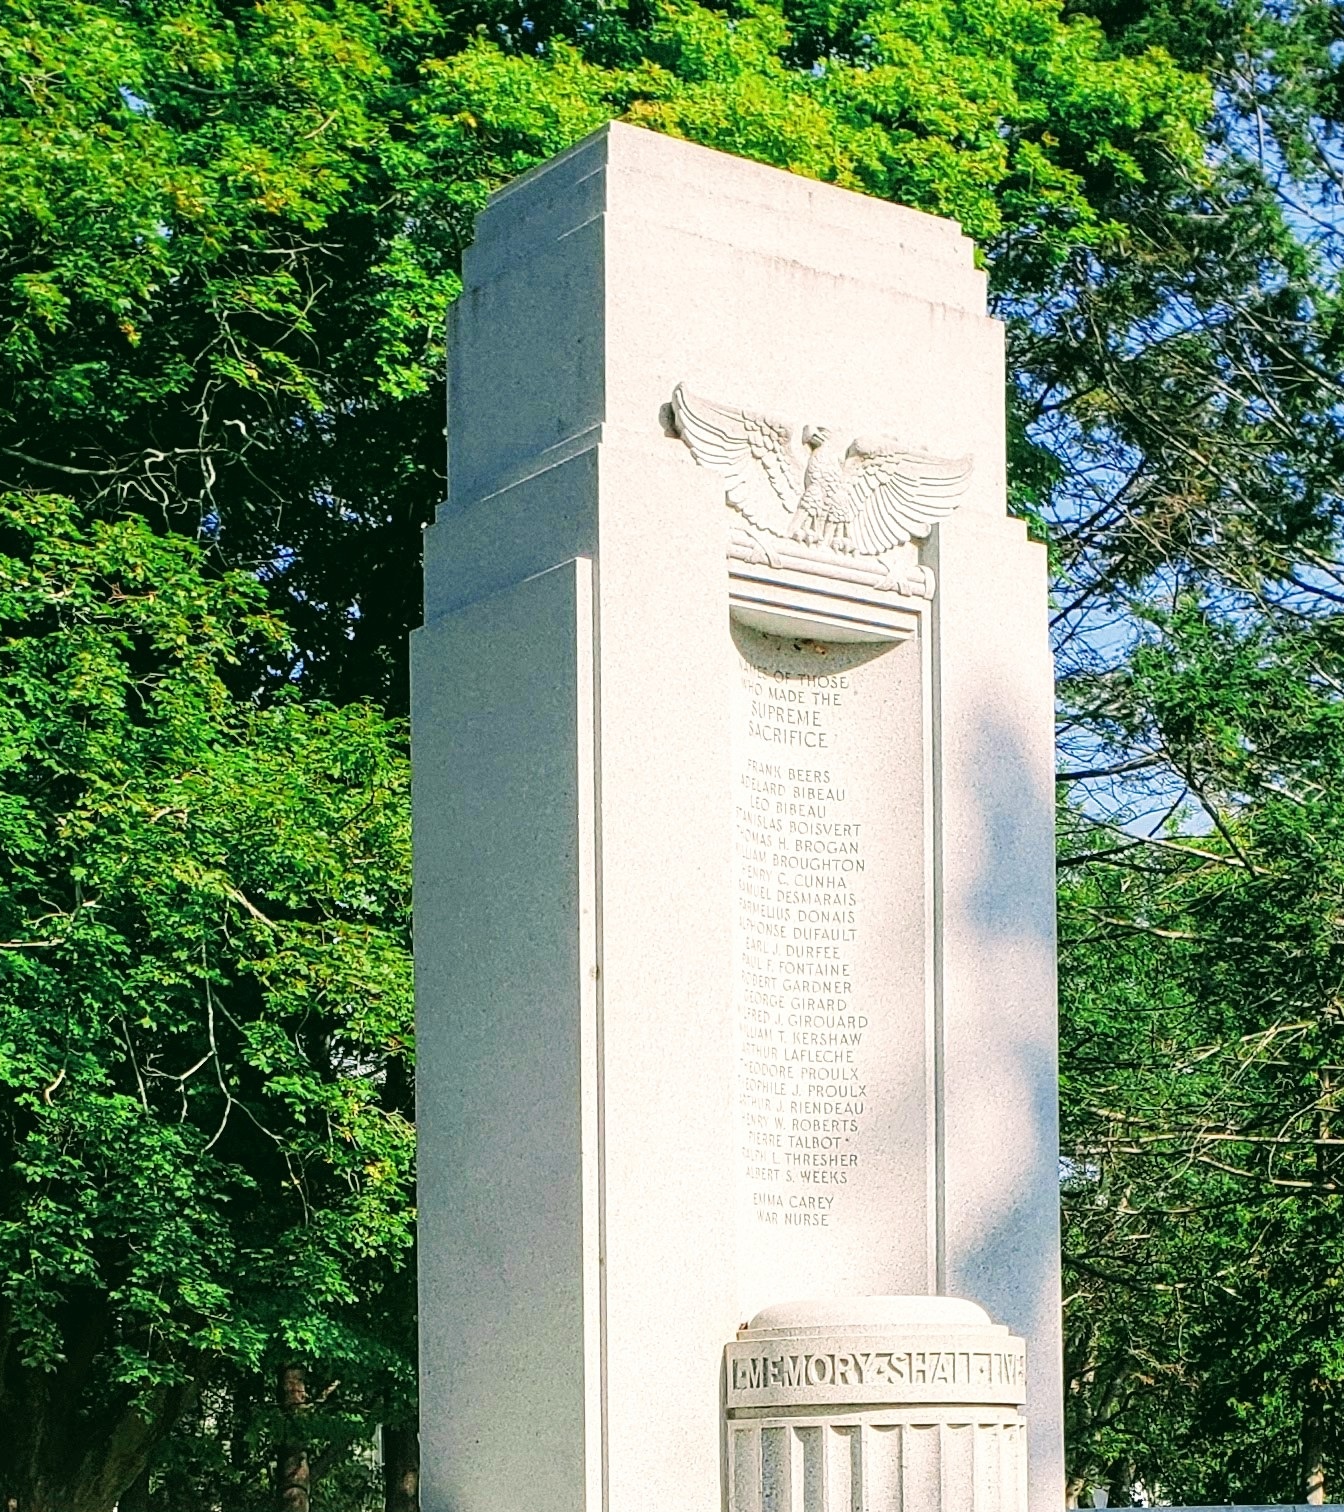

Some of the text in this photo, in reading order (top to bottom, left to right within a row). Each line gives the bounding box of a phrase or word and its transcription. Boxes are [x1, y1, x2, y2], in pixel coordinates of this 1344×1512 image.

[773, 670, 791, 684] OF
[797, 673, 849, 689] THOSE
[768, 687, 805, 704] MADE
[812, 692, 842, 706] THE
[751, 700, 822, 727] SUPREME
[748, 720, 829, 748] SACRIFICE
[748, 758, 831, 784] FRANK BEERS
[740, 773, 845, 802] ADELARD BIBEAU
[750, 794, 826, 819] LEO BIBEAU
[789, 820, 862, 837] BOISVERT
[778, 836, 789, 850] H.
[795, 839, 859, 855] BROGAN
[772, 853, 865, 872] BROUGHTON
[794, 873, 847, 889] CUNHA
[777, 889, 857, 907] DESMARAIS
[798, 909, 855, 924] DONAIS
[793, 926, 857, 941] DUFAULT
[746, 936, 769, 954] EARL
[786, 944, 840, 960] DURFEE
[779, 961, 850, 977] FONTAINE
[783, 978, 852, 994] GARDNER
[744, 988, 847, 1012] GEORGE GIRARD
[788, 1014, 868, 1029] GIROUARD
[793, 1031, 862, 1046] KERSHAW
[784, 1048, 854, 1063] LAFLECHE
[740, 1057, 859, 1081] HEODORE PROULX
[737, 1074, 787, 1096] EOPHILE
[808, 1084, 867, 1098] PROULX
[790, 1101, 864, 1116] RIENDEAU
[792, 1118, 858, 1133] ROBERTS
[787, 1135, 842, 1150] TALBOT
[784, 1152, 858, 1167] THRESHER
[785, 1169, 795, 1183] S.
[800, 1170, 848, 1184] WEEKS
[753, 1192, 834, 1210] EMMA CAREY
[757, 1210, 829, 1227] WAR NURSE
[748, 1353, 875, 1389] MEMORY
